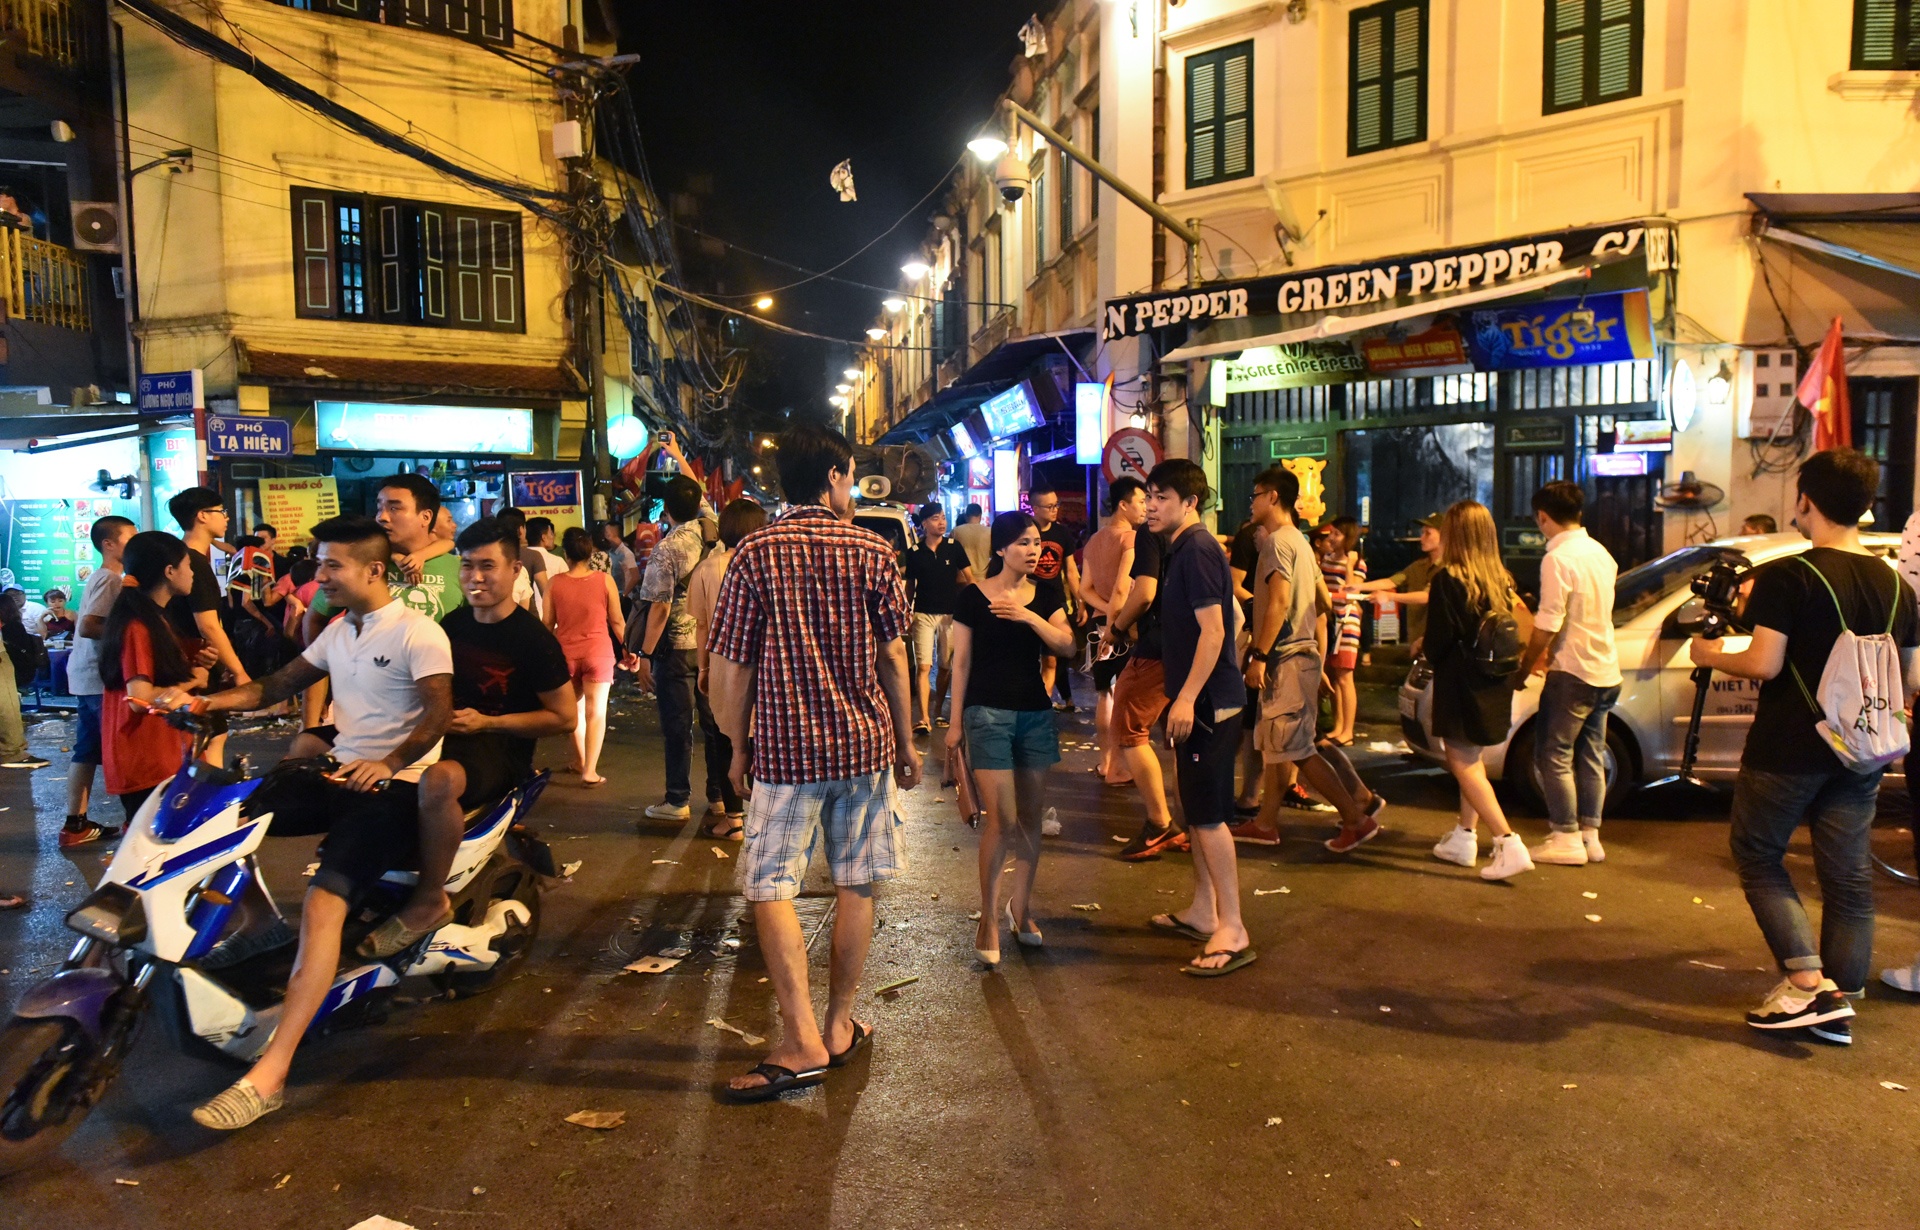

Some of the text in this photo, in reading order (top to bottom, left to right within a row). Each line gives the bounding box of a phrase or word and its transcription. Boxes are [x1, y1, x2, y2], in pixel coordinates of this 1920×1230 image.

[1278, 241, 1564, 314] GREEN PEPPER
[1103, 288, 1248, 340] N PEPPER
[1502, 312, 1618, 360] Tiger
[1247, 362, 1297, 378] GREEN
[1300, 356, 1362, 373] PEPPER
[158, 379, 176, 389] PHỐ
[235, 422, 263, 433] PHỐ
[218, 434, 282, 454] TẠ HIỆN
[268, 483, 286, 491] BIA
[525, 479, 574, 503] Tiger
[540, 508, 559, 516] PHỐ
[1712, 680, 1744, 692] VIET
[331, 979, 359, 1013] 1
